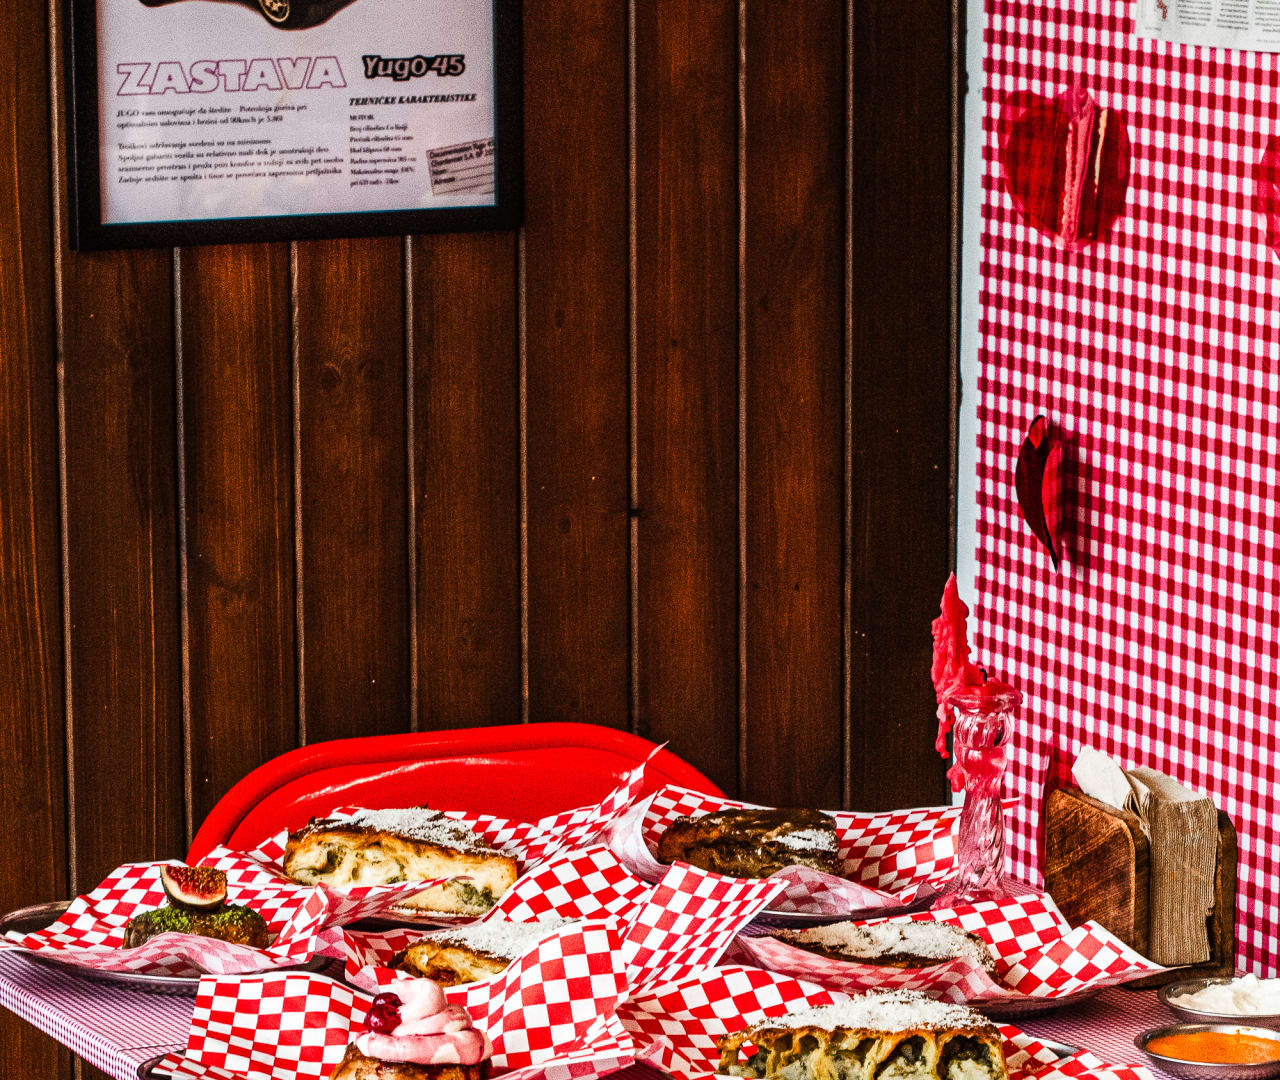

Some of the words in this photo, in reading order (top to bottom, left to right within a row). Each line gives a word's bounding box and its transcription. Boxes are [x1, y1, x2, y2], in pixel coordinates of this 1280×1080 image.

[117, 56, 347, 96] ZASTAVA
[431, 54, 465, 77] 45
[398, 93, 477, 105] KARAKTERISTIKE
